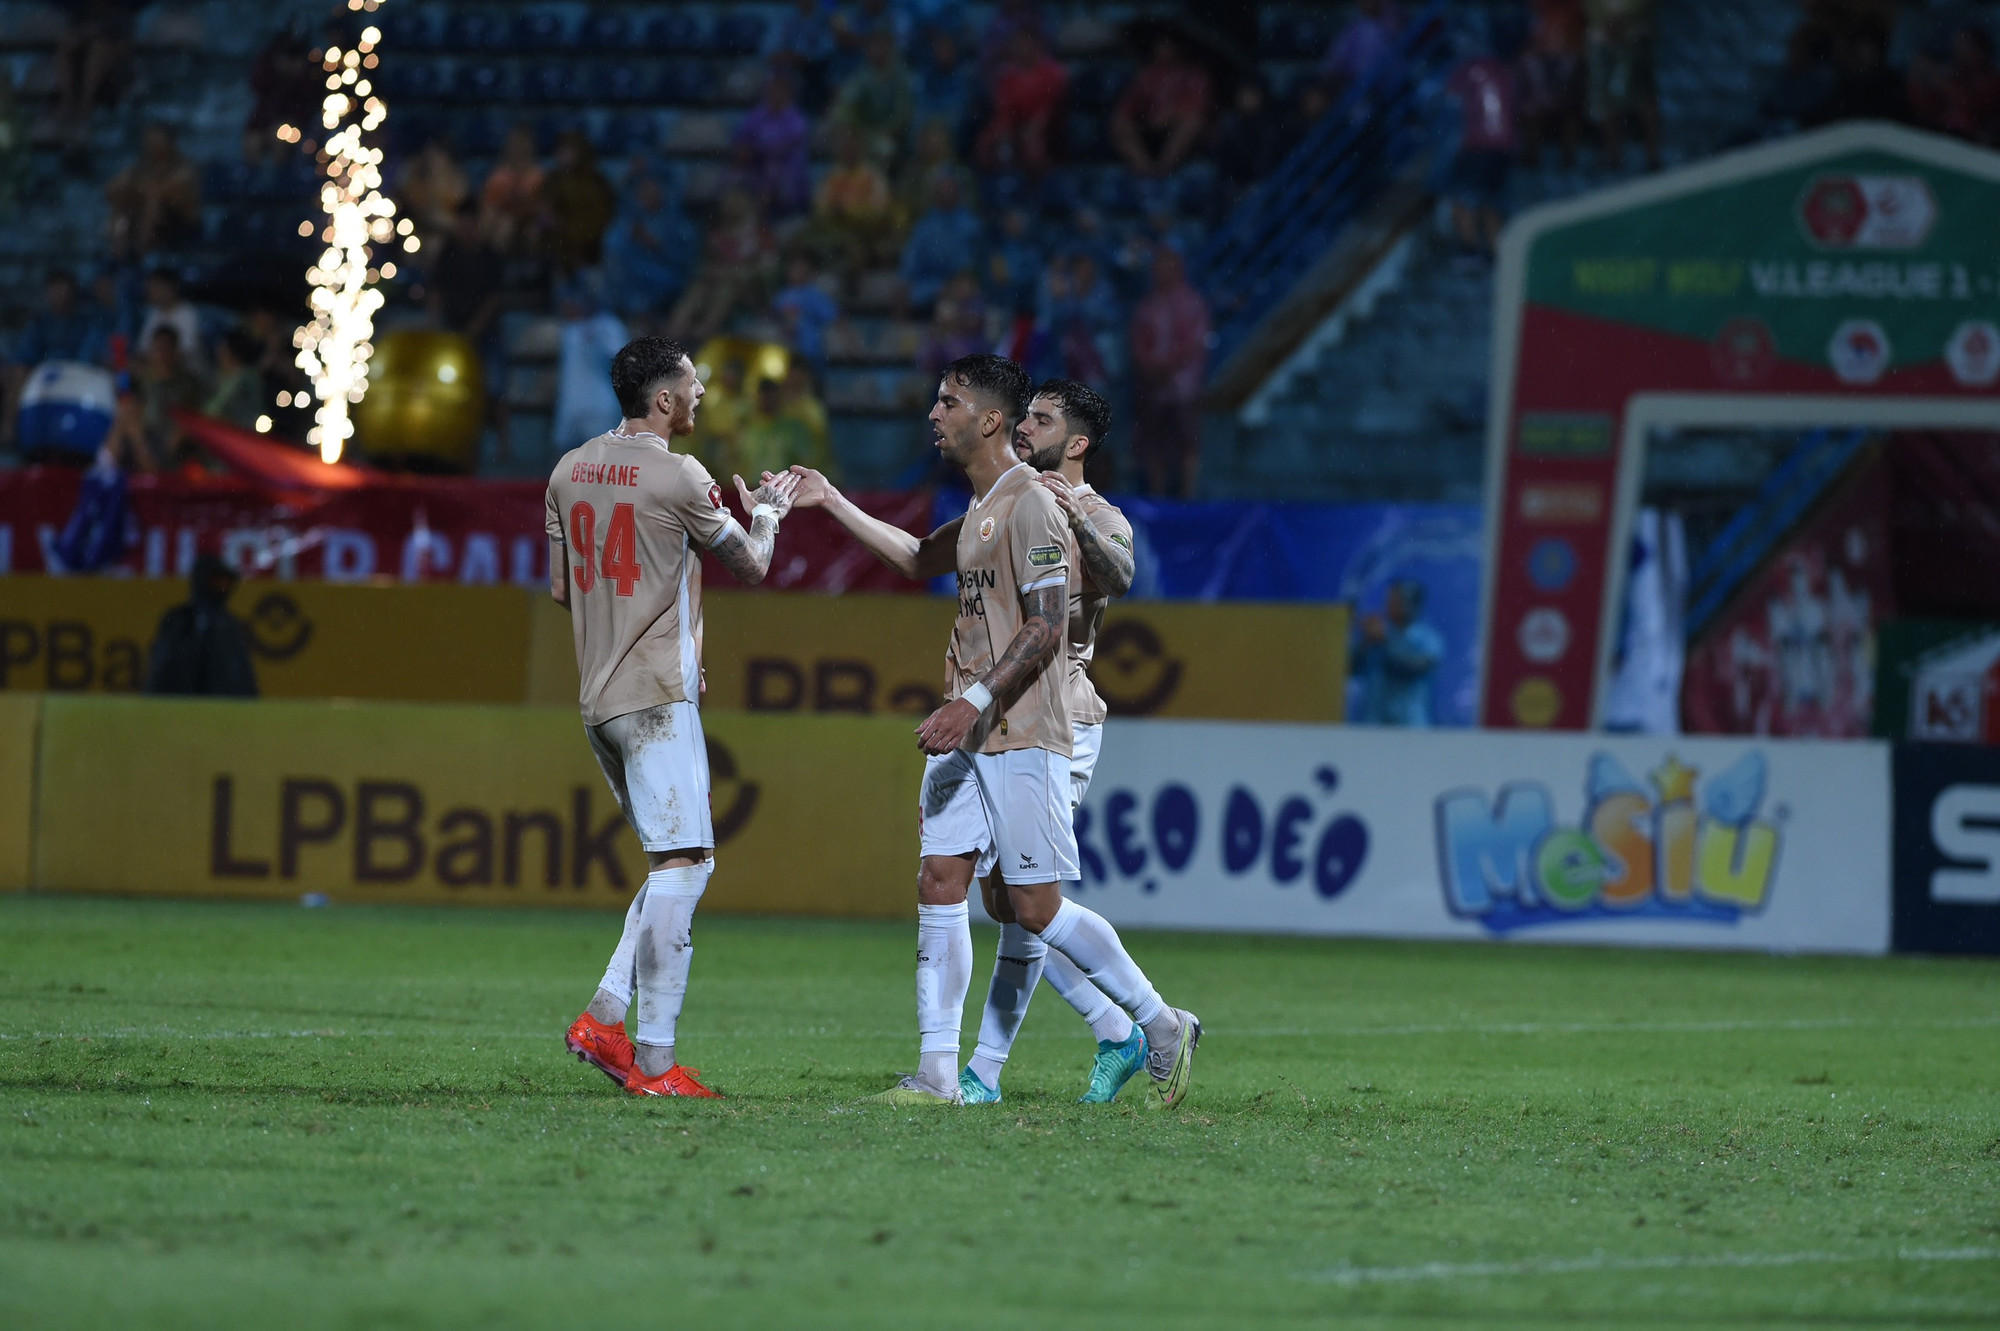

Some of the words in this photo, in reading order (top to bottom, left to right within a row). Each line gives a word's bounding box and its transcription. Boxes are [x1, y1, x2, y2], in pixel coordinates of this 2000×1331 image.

[571, 462, 640, 487] GEOVANE
[570, 501, 641, 597] 94
[0, 618, 142, 691] PBa
[210, 773, 634, 889] LPBank
